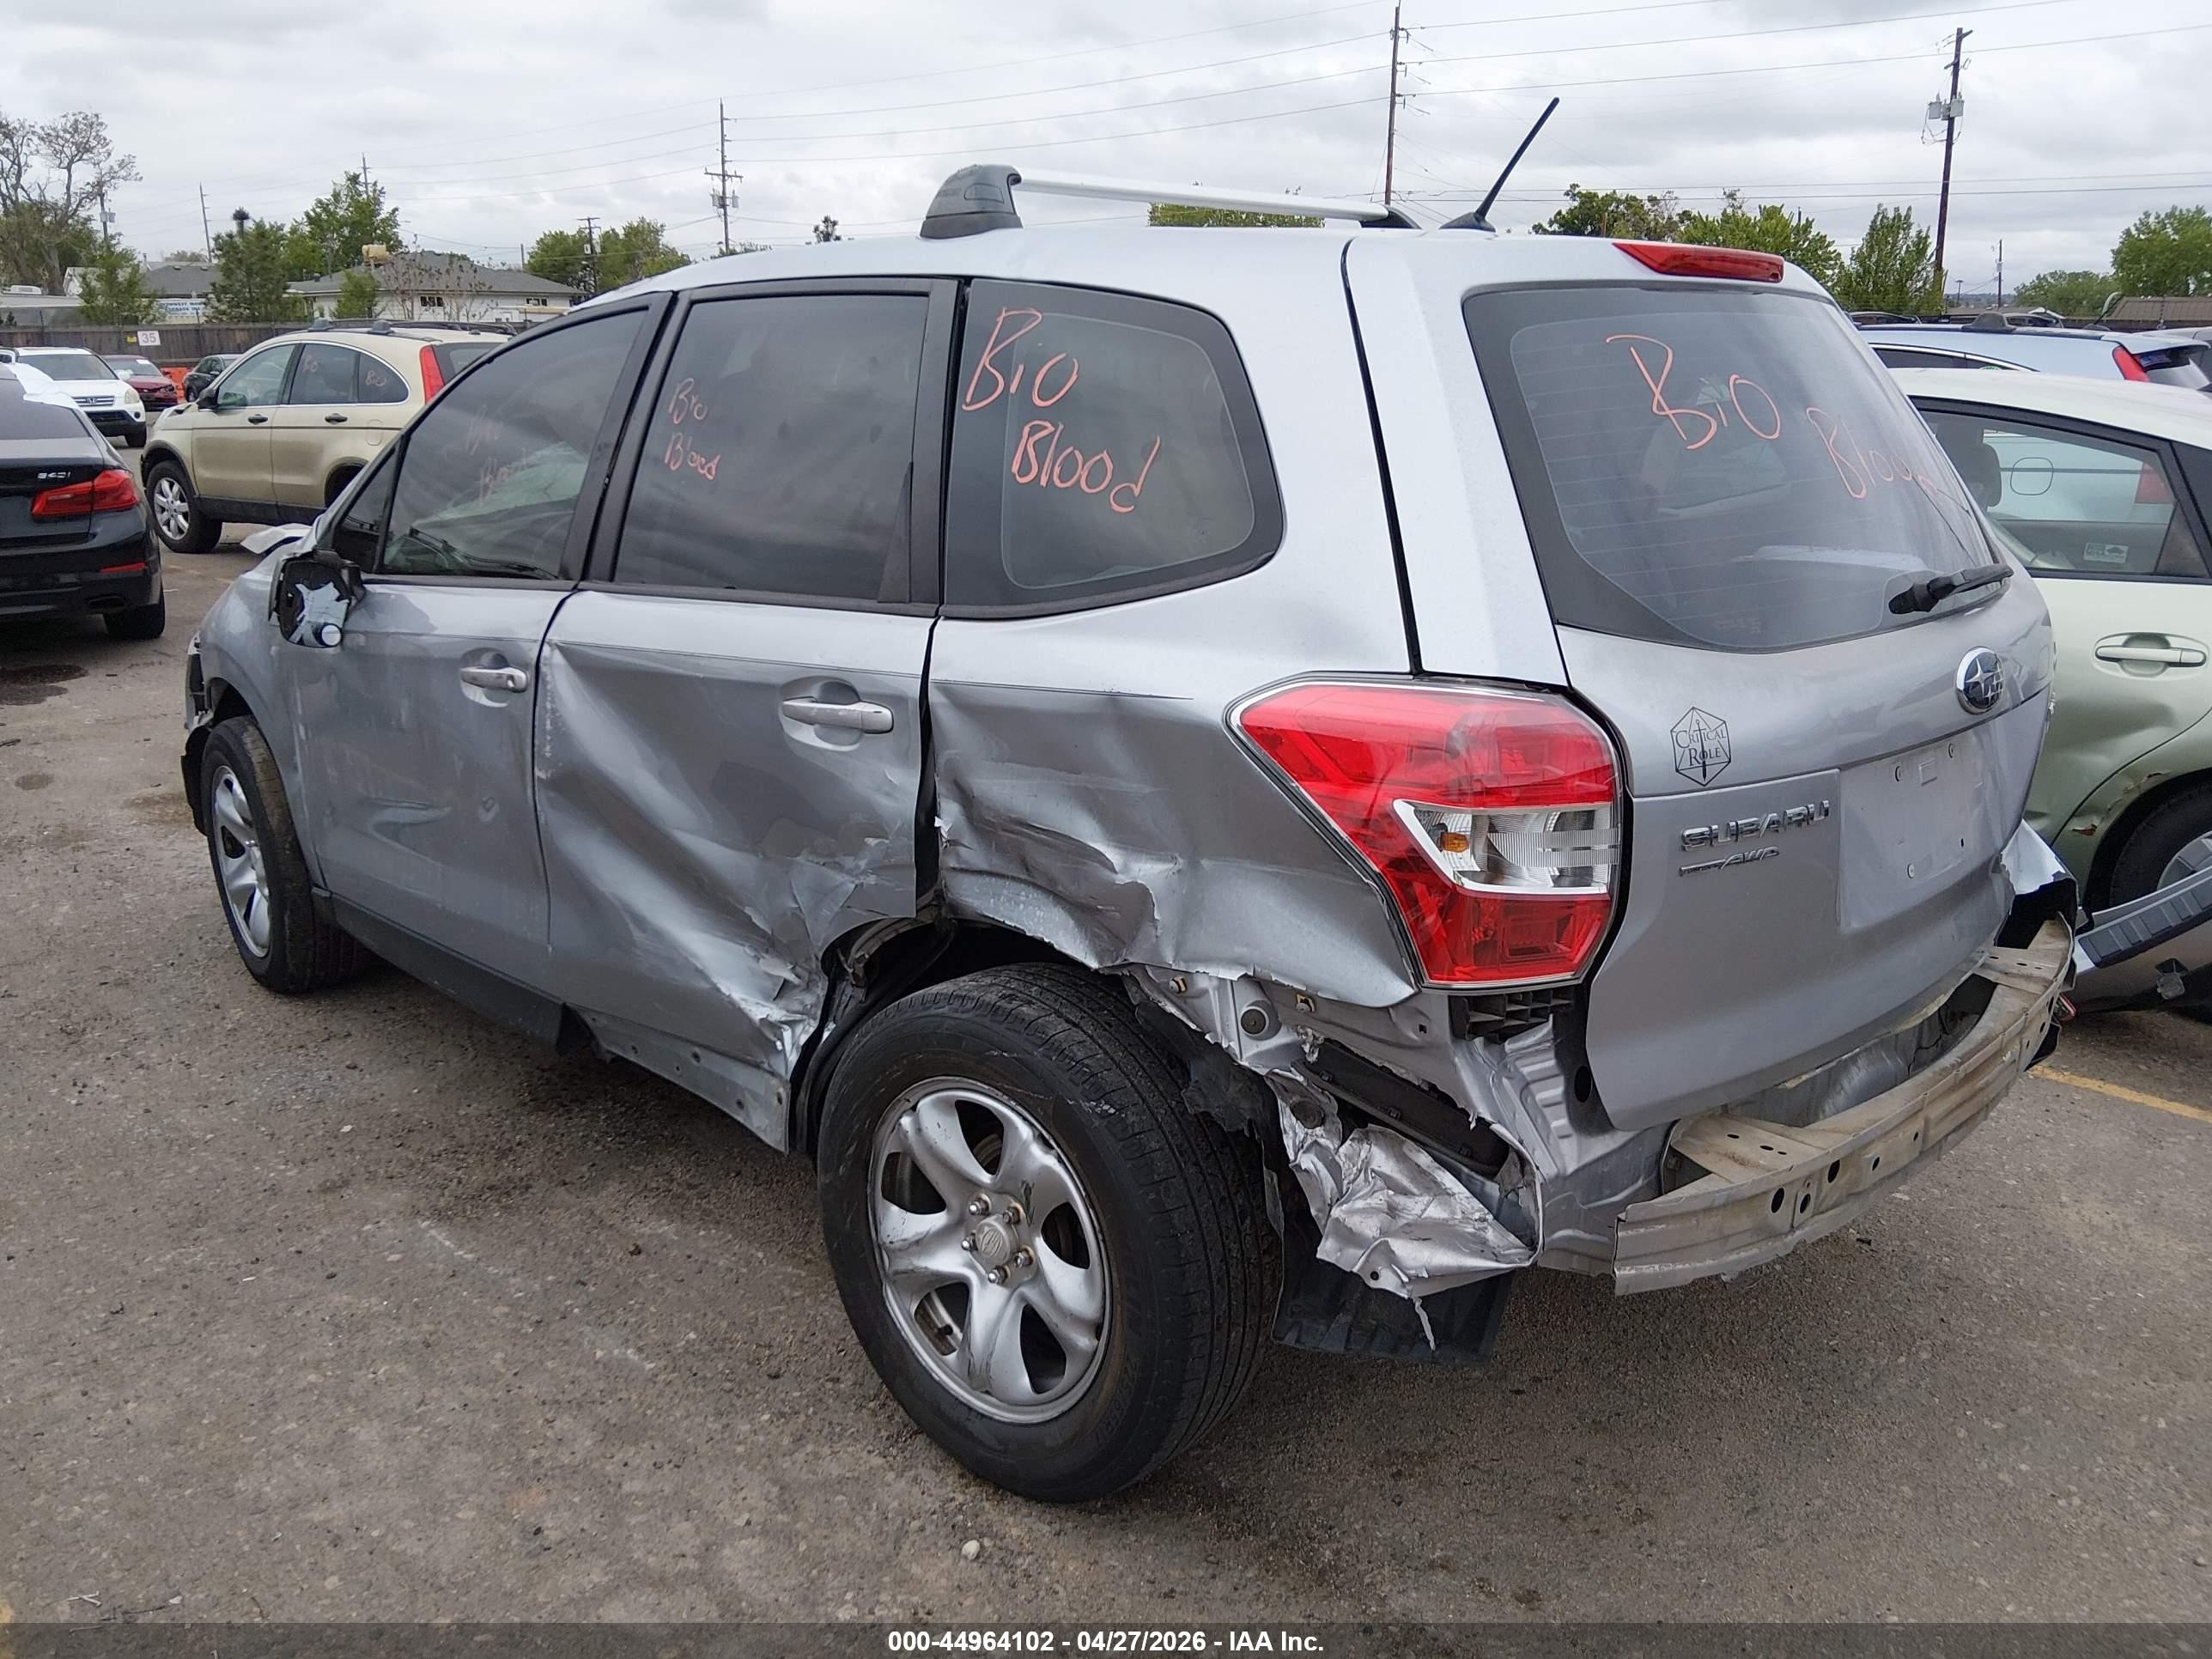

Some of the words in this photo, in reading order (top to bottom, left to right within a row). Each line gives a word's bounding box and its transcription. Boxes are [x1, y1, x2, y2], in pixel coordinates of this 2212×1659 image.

[142, 332, 156, 343] 35
[1011, 419, 1160, 513] Blood
[1675, 728, 1727, 749] CRITICAL
[1688, 747, 1721, 766] ROLE
[1681, 799, 1830, 851] SUBARU
[1720, 846, 1779, 872] AWD
